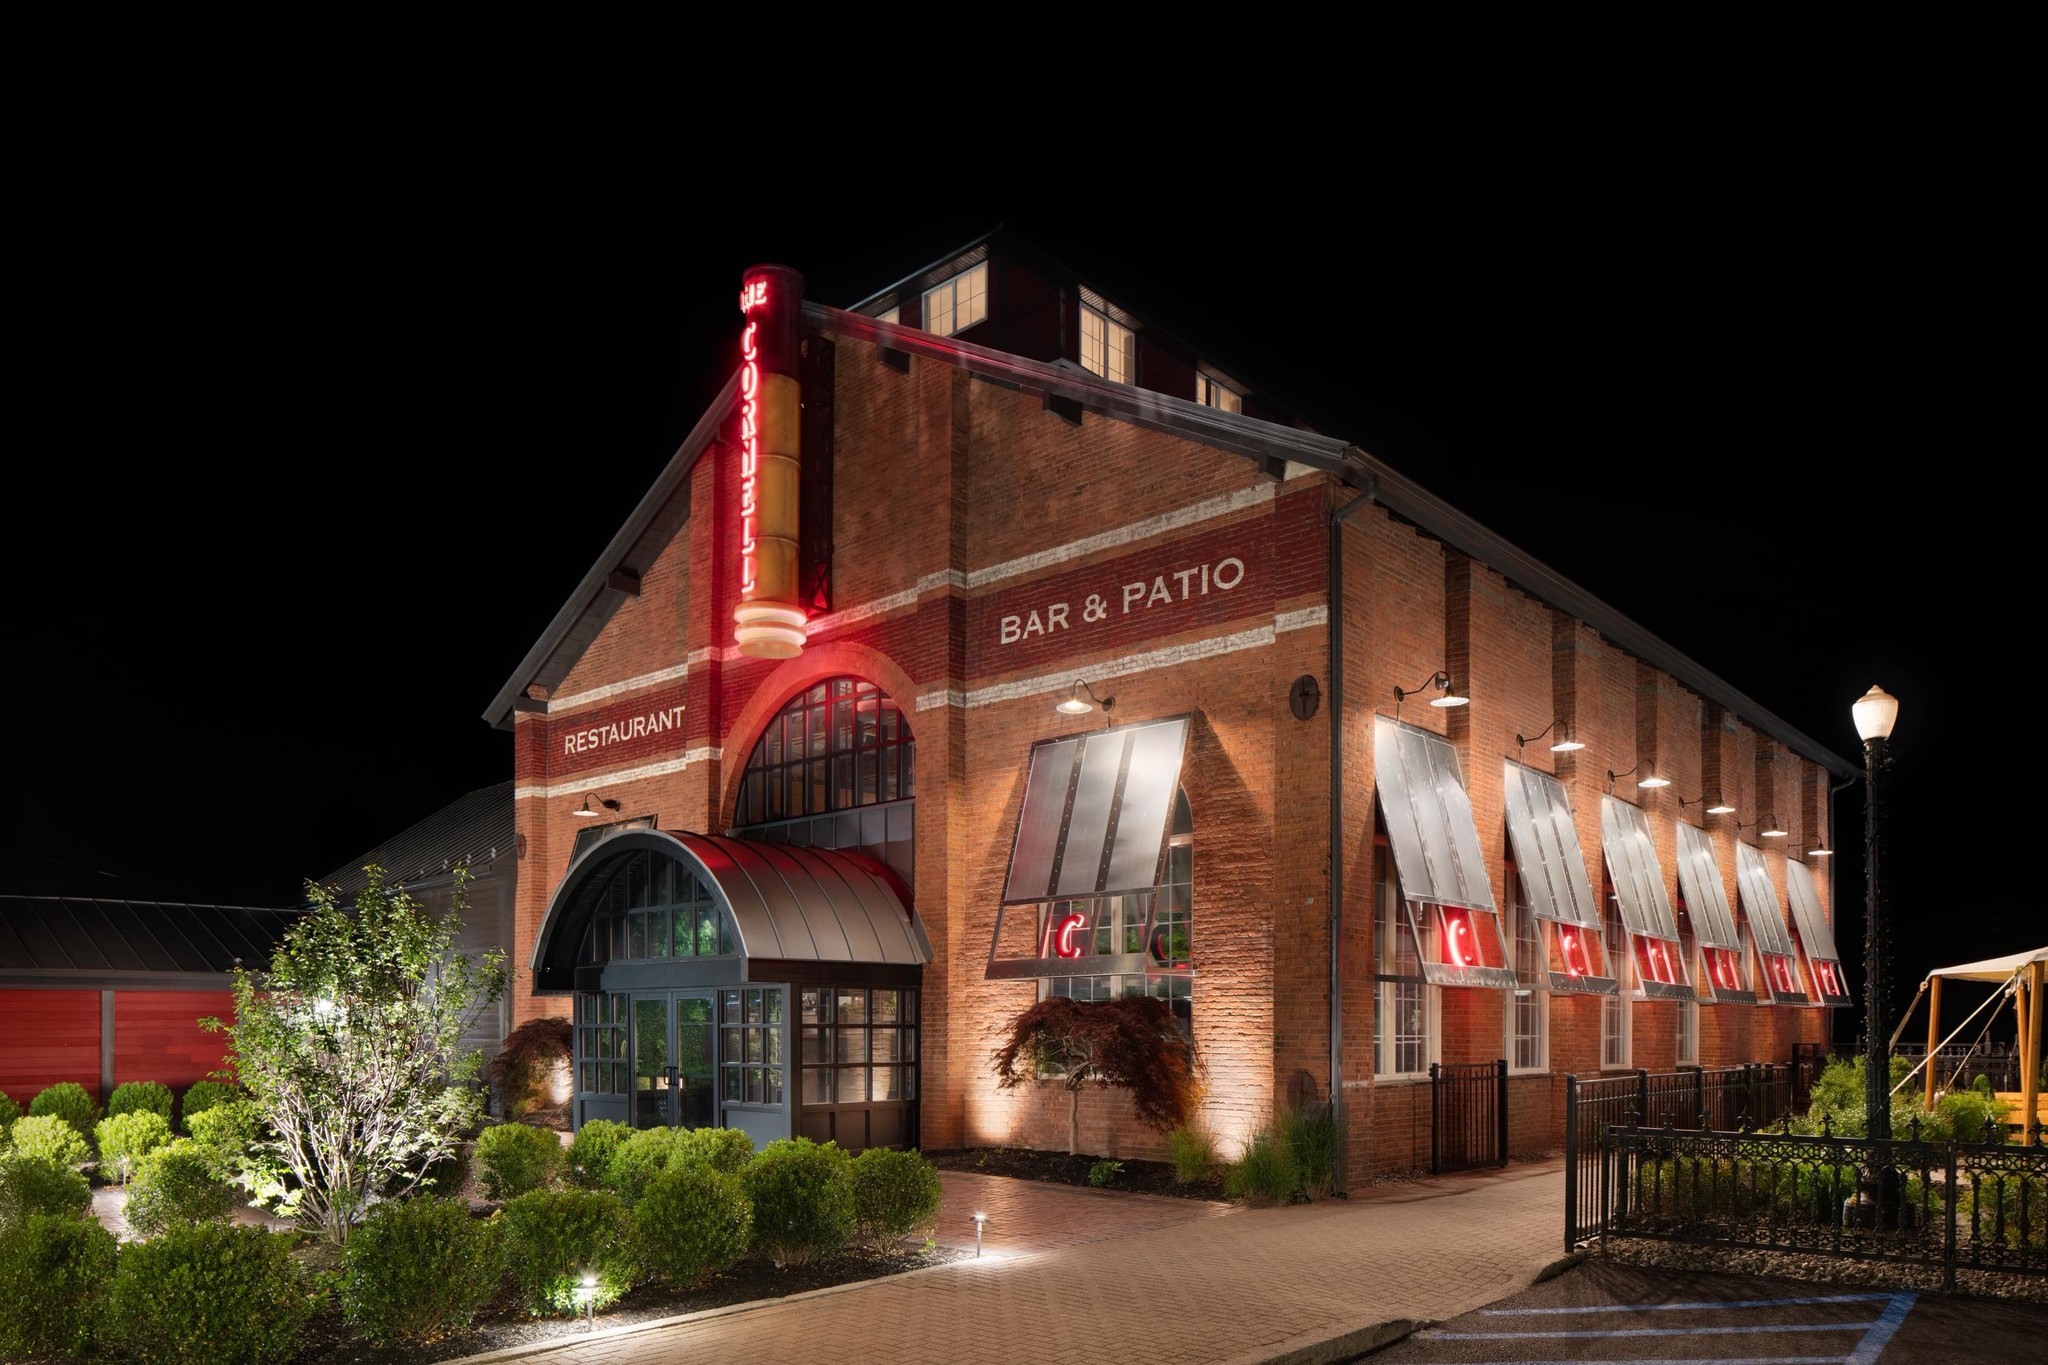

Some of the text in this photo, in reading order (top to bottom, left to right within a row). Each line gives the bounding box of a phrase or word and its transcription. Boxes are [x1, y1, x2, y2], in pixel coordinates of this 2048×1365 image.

[1000, 557, 1245, 645] BAR & PATIO
[564, 705, 686, 755] RESTAURANT
[1054, 914, 1085, 959] C
